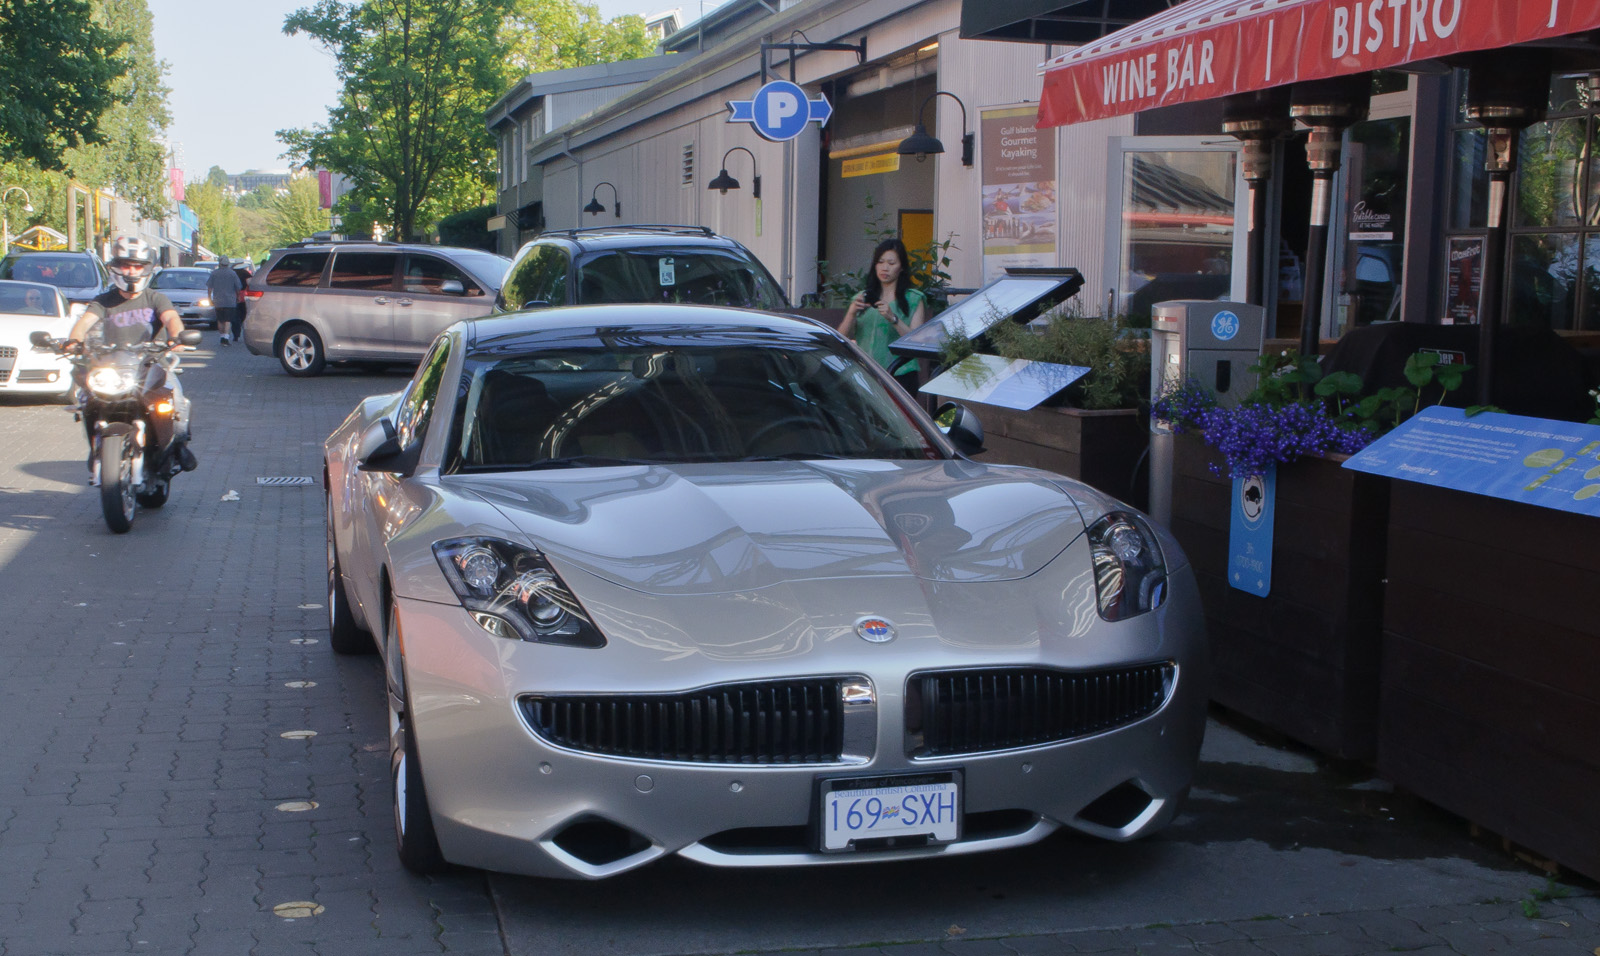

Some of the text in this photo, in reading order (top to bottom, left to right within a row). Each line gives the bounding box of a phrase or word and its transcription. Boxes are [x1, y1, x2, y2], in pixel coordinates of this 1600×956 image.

[1332, 0, 1462, 59] BISTRO
[1103, 39, 1215, 105] WINE BAR
[767, 92, 798, 128] P
[1000, 125, 1037, 135] Gulf Islands
[1001, 136, 1037, 146] Gourmet
[1001, 147, 1038, 160] Kayaking
[834, 783, 947, 798] Beautiful British Columbia
[831, 791, 955, 831] 169 SXH
